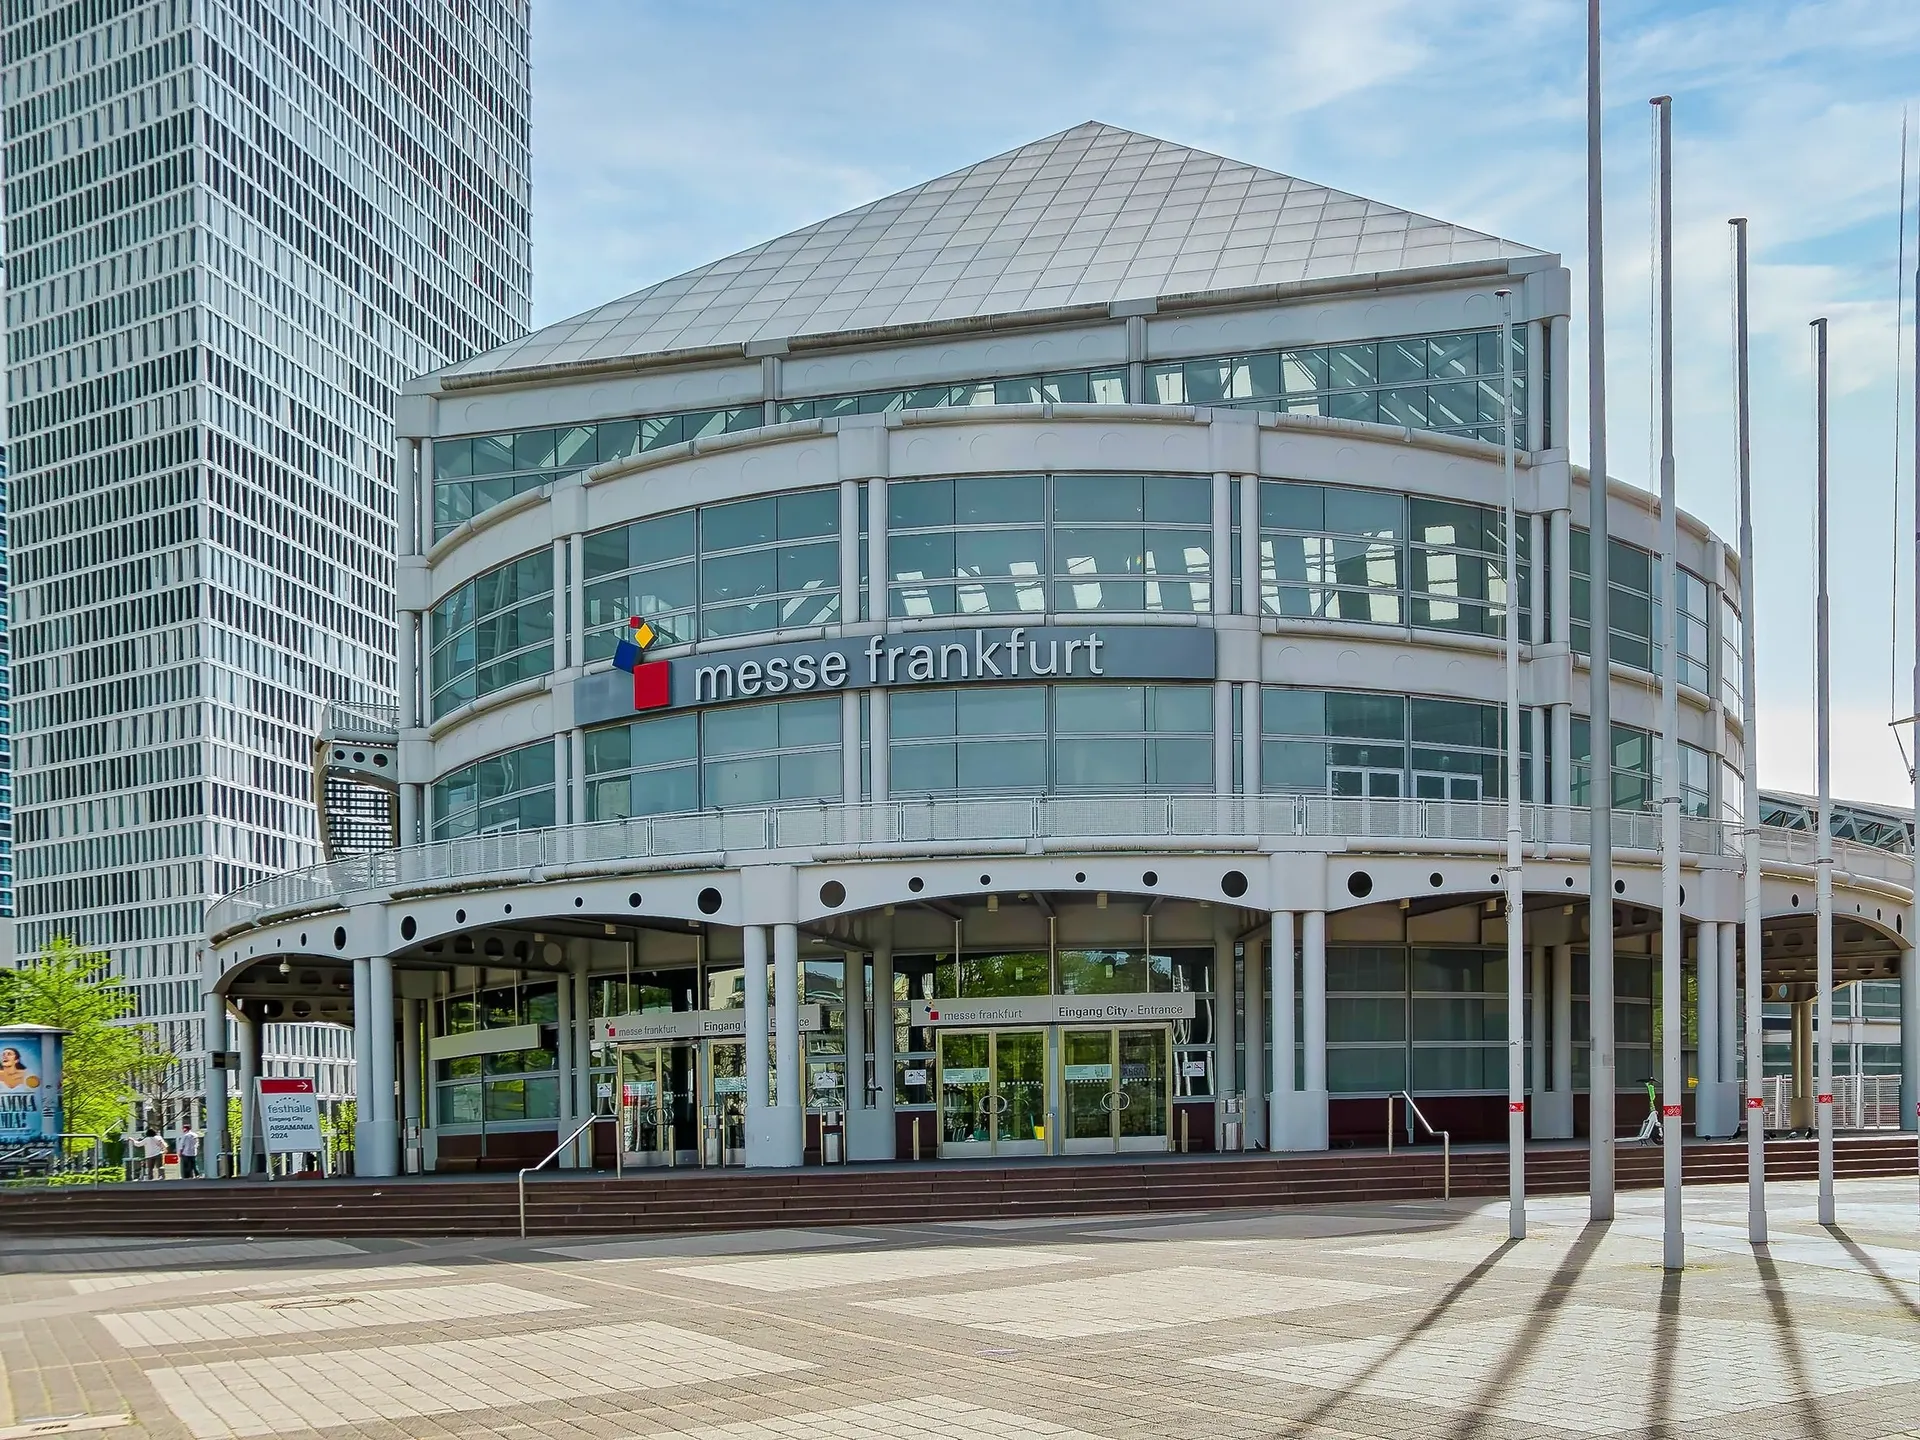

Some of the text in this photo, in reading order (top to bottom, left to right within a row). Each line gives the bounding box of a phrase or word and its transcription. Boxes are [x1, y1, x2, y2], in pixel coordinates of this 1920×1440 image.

[695, 627, 1104, 701] messe frankfurt
[943, 1008, 1022, 1020] messe frankfurt
[1058, 1004, 1183, 1019] Eingang City Entrance
[618, 1024, 677, 1037] messe frankfurt
[703, 1021, 741, 1032] Eingang
[267, 1104, 312, 1114] festhalle
